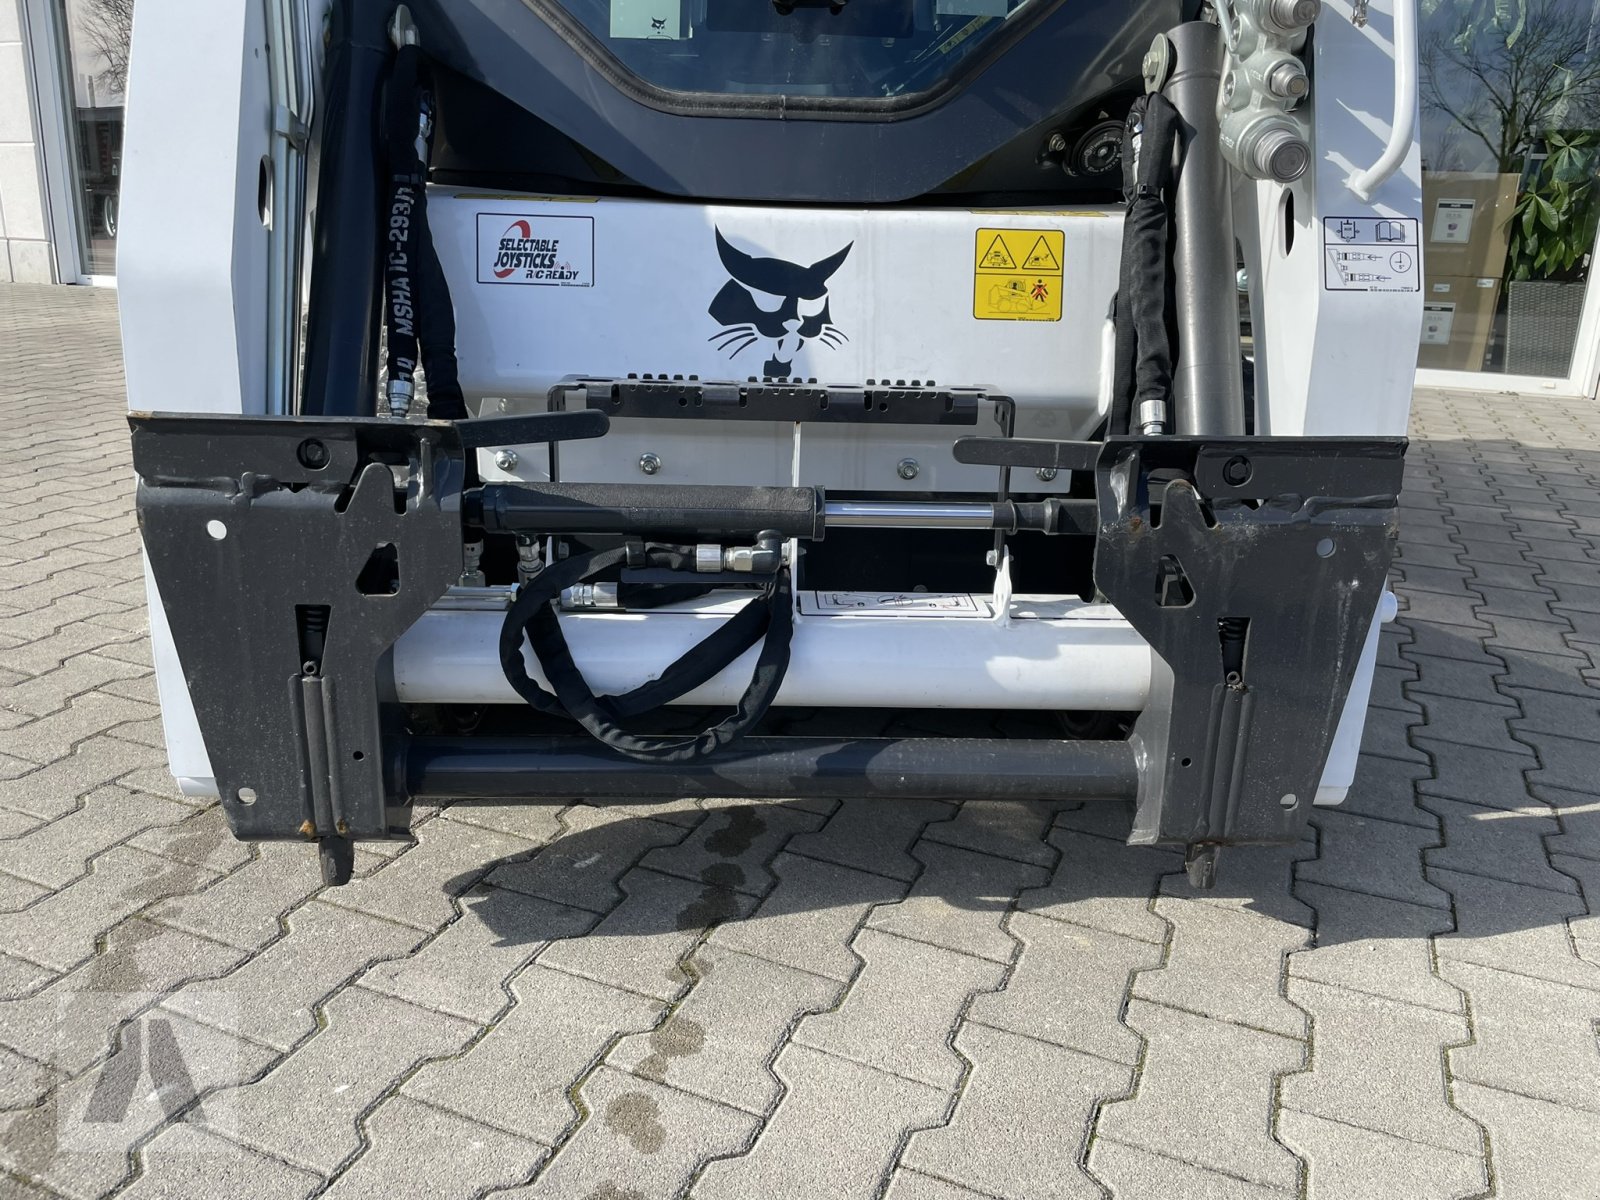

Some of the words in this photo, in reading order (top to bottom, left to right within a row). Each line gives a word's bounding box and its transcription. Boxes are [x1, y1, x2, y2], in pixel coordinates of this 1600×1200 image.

[498, 238, 559, 253] SELECTABLE
[494, 252, 557, 269] JOYSTICKS
[545, 269, 580, 281] READY
[391, 277, 414, 337] MSHA
